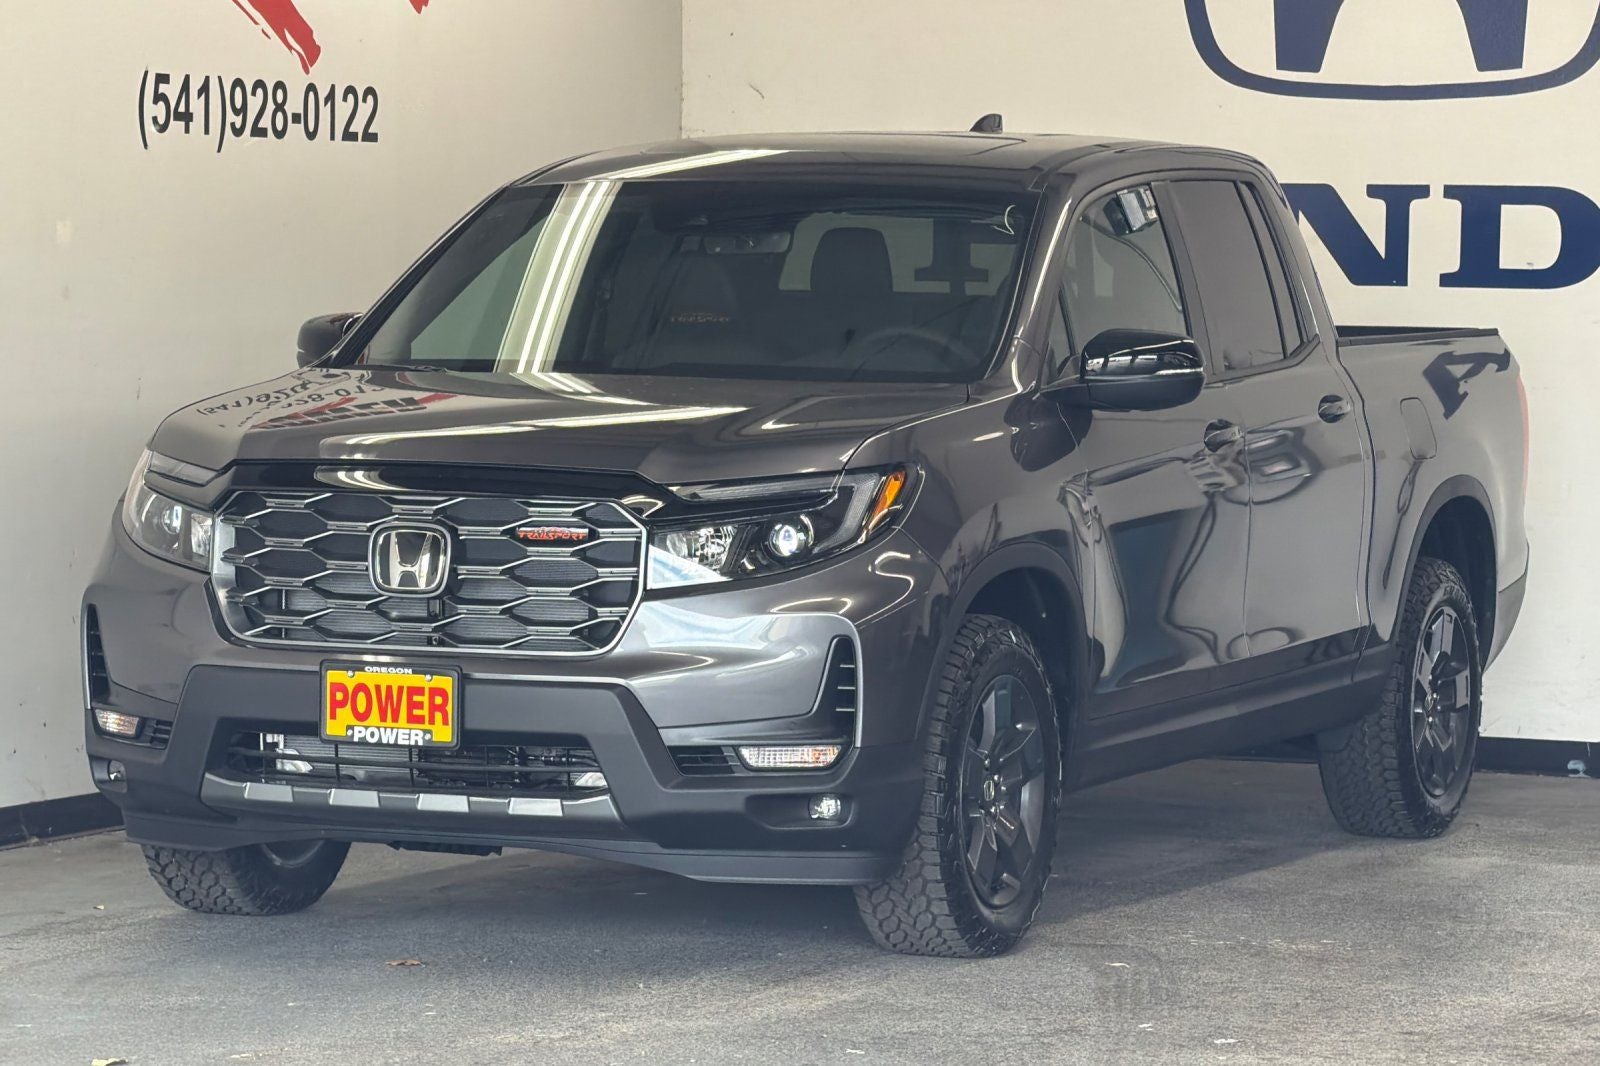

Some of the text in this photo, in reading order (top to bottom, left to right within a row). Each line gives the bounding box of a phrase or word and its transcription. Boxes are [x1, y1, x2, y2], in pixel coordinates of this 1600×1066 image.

[138, 66, 379, 153] (541)928-0122
[364, 666, 413, 675] OREGON
[329, 682, 450, 726] POWER
[353, 726, 424, 746] POWER
